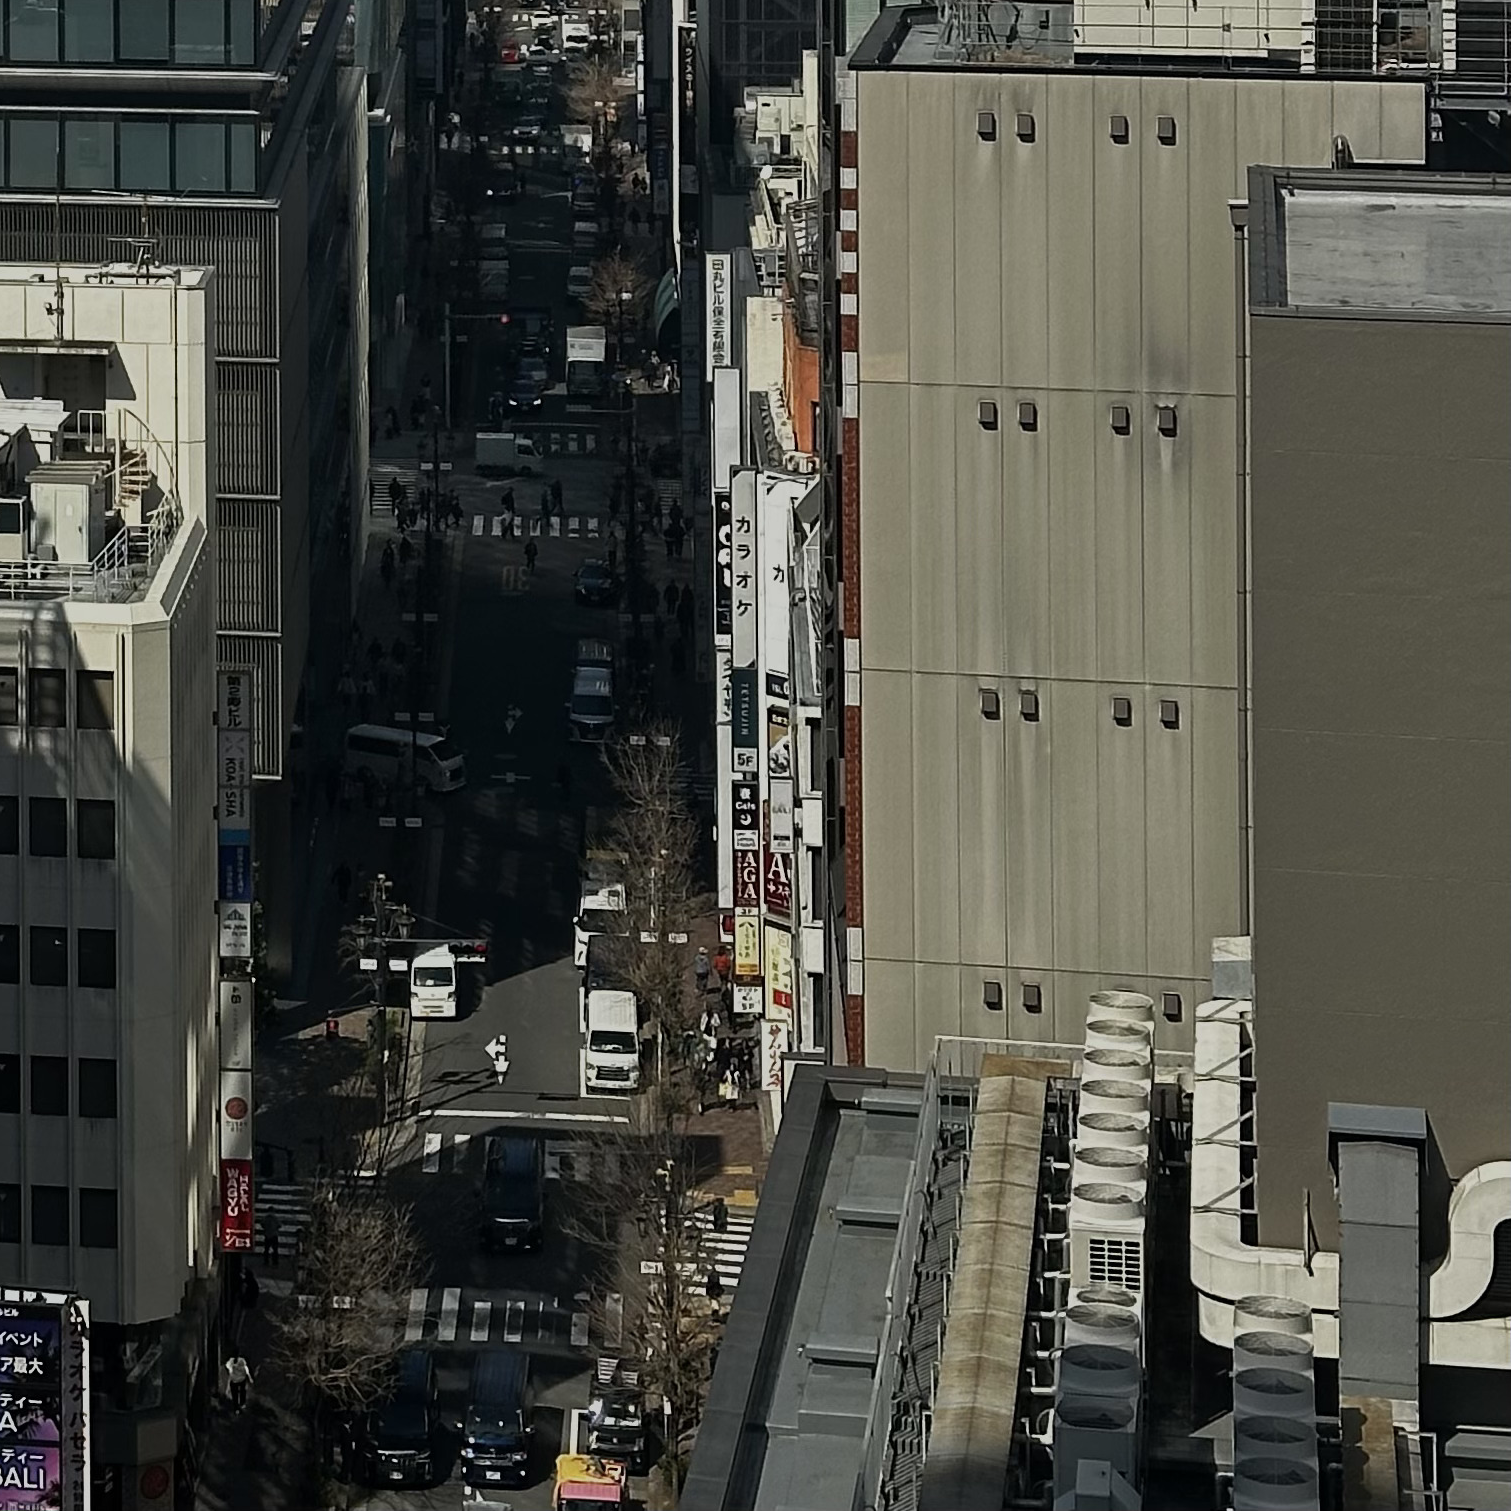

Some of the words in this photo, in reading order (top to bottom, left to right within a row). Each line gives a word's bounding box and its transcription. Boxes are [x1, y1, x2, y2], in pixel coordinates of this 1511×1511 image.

[735, 516, 753, 617] カラオケ
[737, 753, 754, 767] 5F
[742, 851, 757, 899] AGA
[226, 1167, 239, 1217] WAGYU
